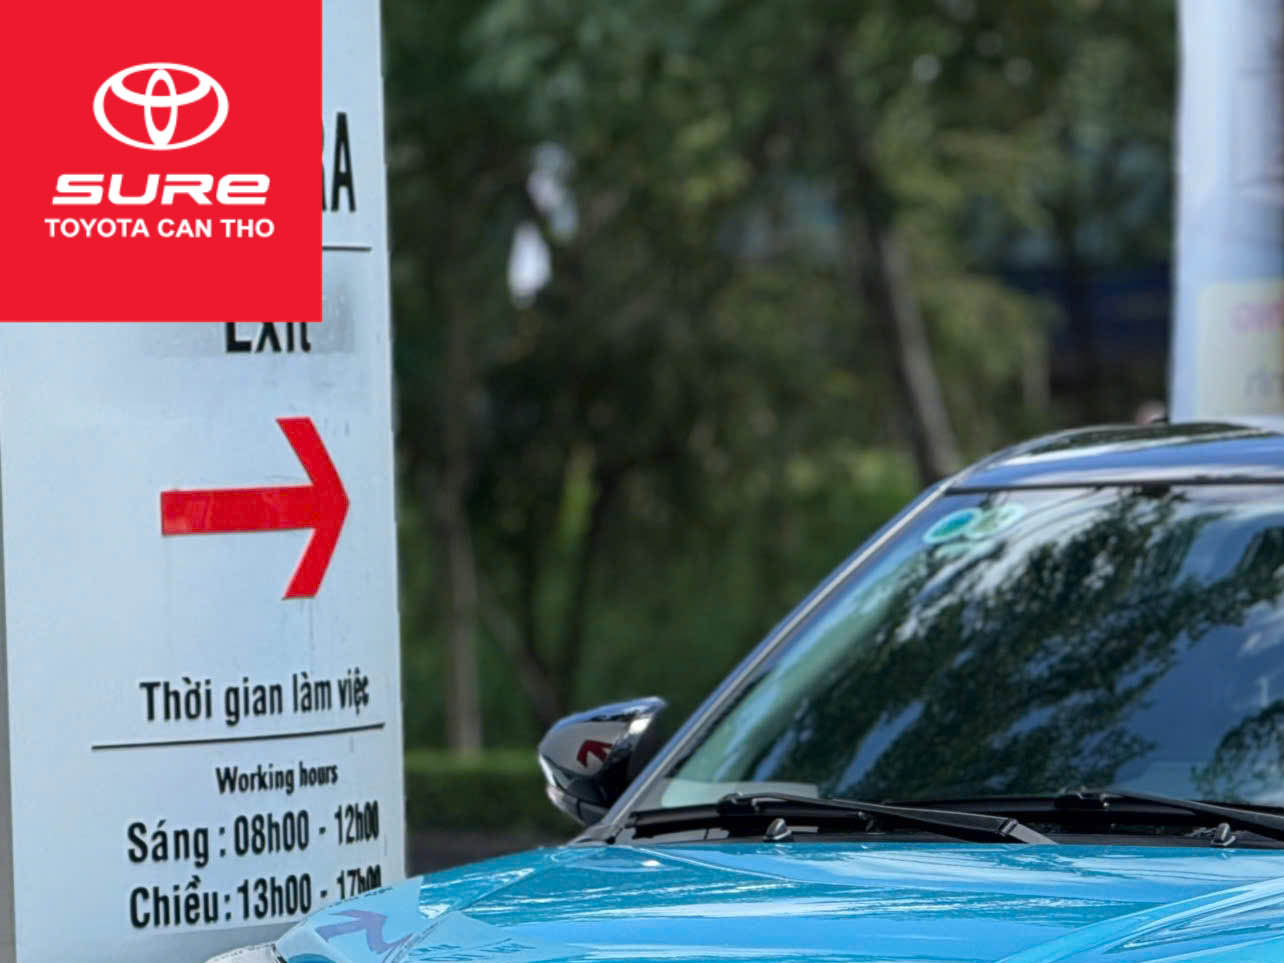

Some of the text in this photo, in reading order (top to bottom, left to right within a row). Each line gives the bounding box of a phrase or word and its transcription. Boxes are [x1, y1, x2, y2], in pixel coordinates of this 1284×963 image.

[322, 111, 356, 213] A
[140, 667, 369, 726] Thời gian làm việc
[216, 761, 338, 795] Working hours
[335, 800, 380, 845] 12h00
